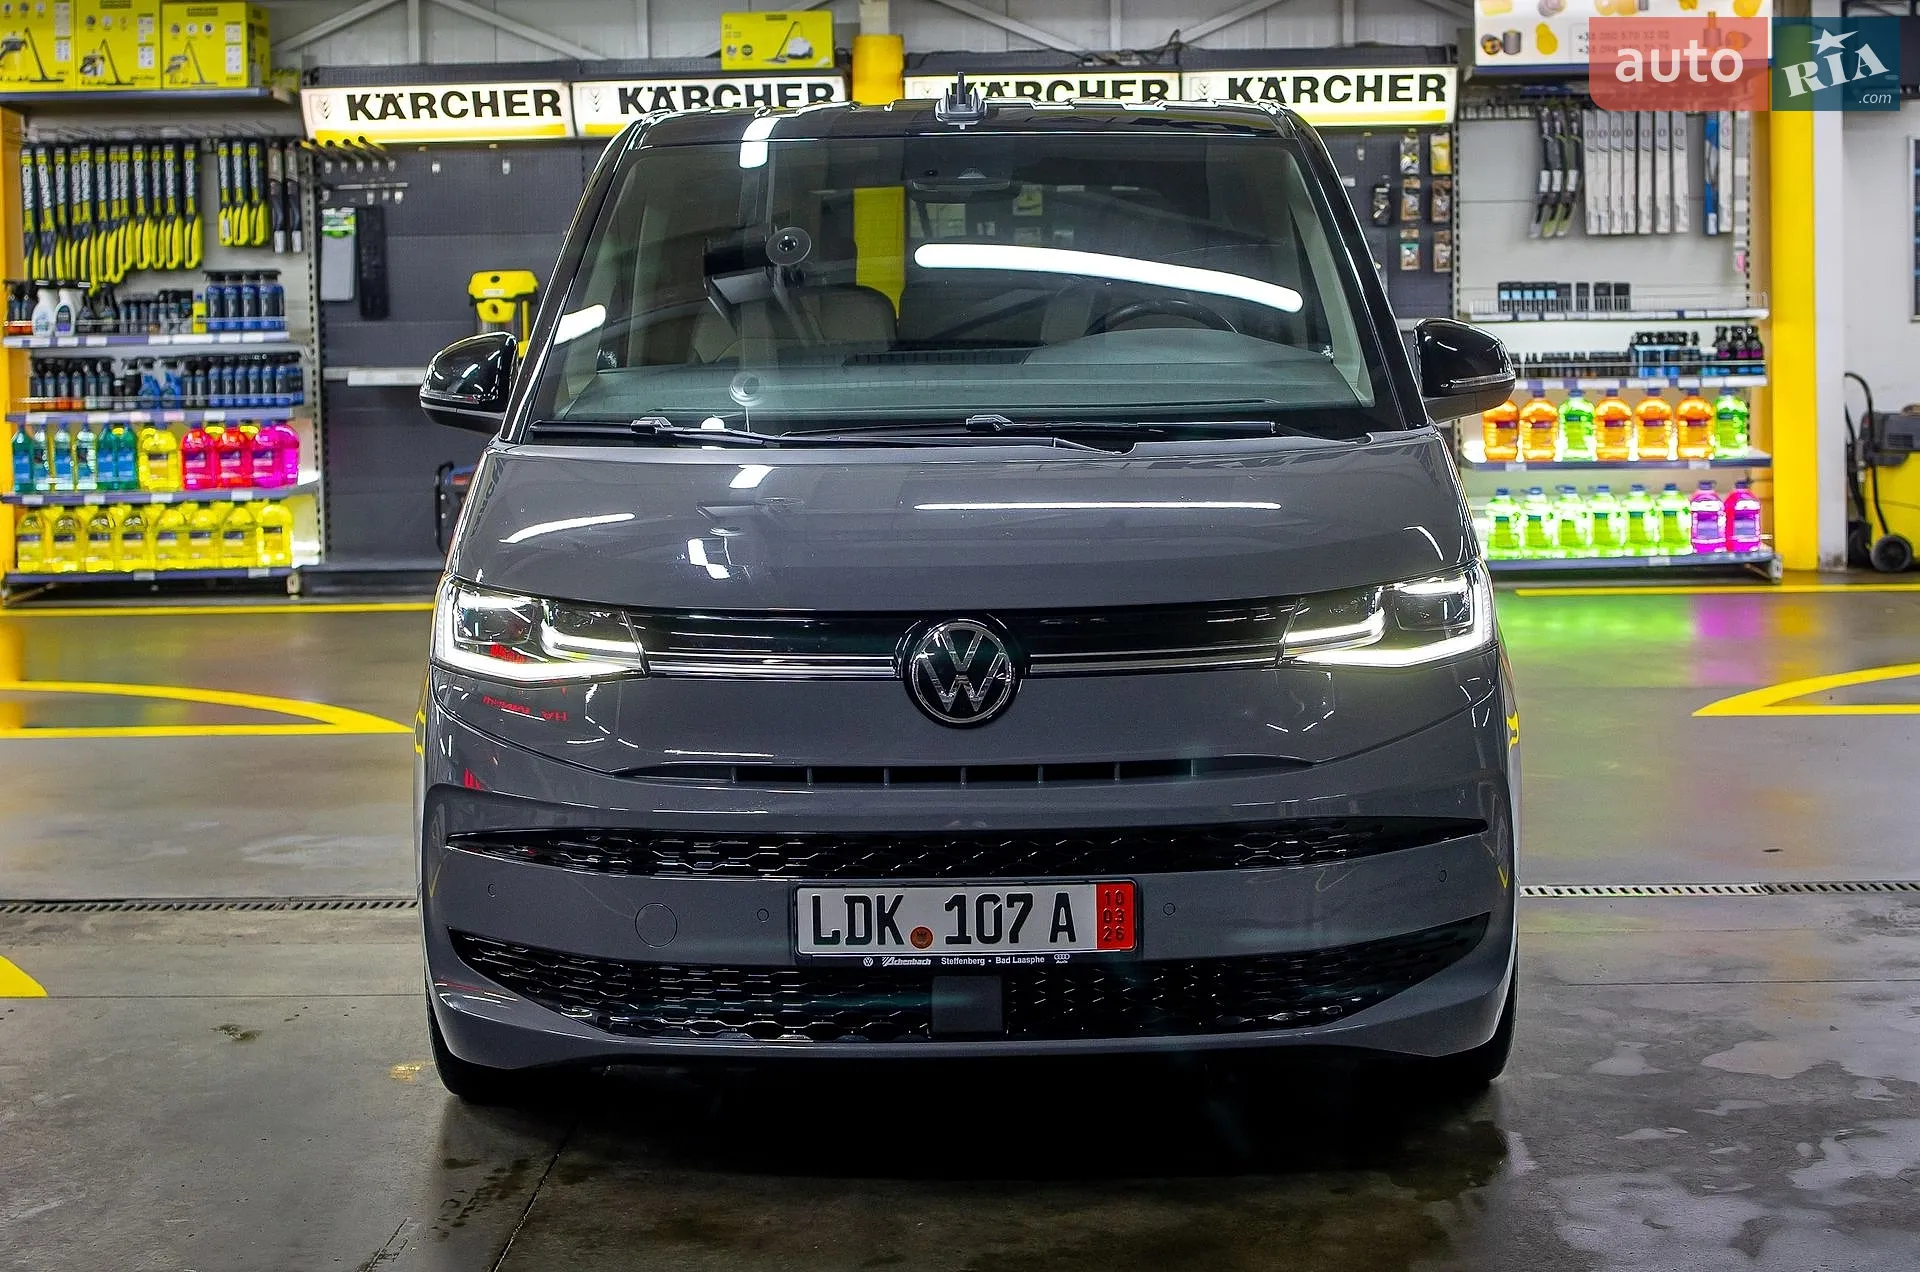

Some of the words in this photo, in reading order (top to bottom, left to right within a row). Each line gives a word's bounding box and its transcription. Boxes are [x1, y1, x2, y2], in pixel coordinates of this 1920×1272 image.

[618, 82, 835, 115] KÄRCHER
[1227, 73, 1446, 104] KÄRCHER
[347, 89, 563, 121] KÄRCHER
[914, 624, 1009, 717] VW
[1103, 889, 1125, 906] 10
[811, 893, 905, 946] LDK
[944, 892, 1034, 946] 107
[1049, 891, 1077, 944] A
[1102, 907, 1125, 924] 03
[1102, 925, 1125, 942] 26
[995, 956, 1011, 964] Bad
[1012, 955, 1045, 965] Laasphe
